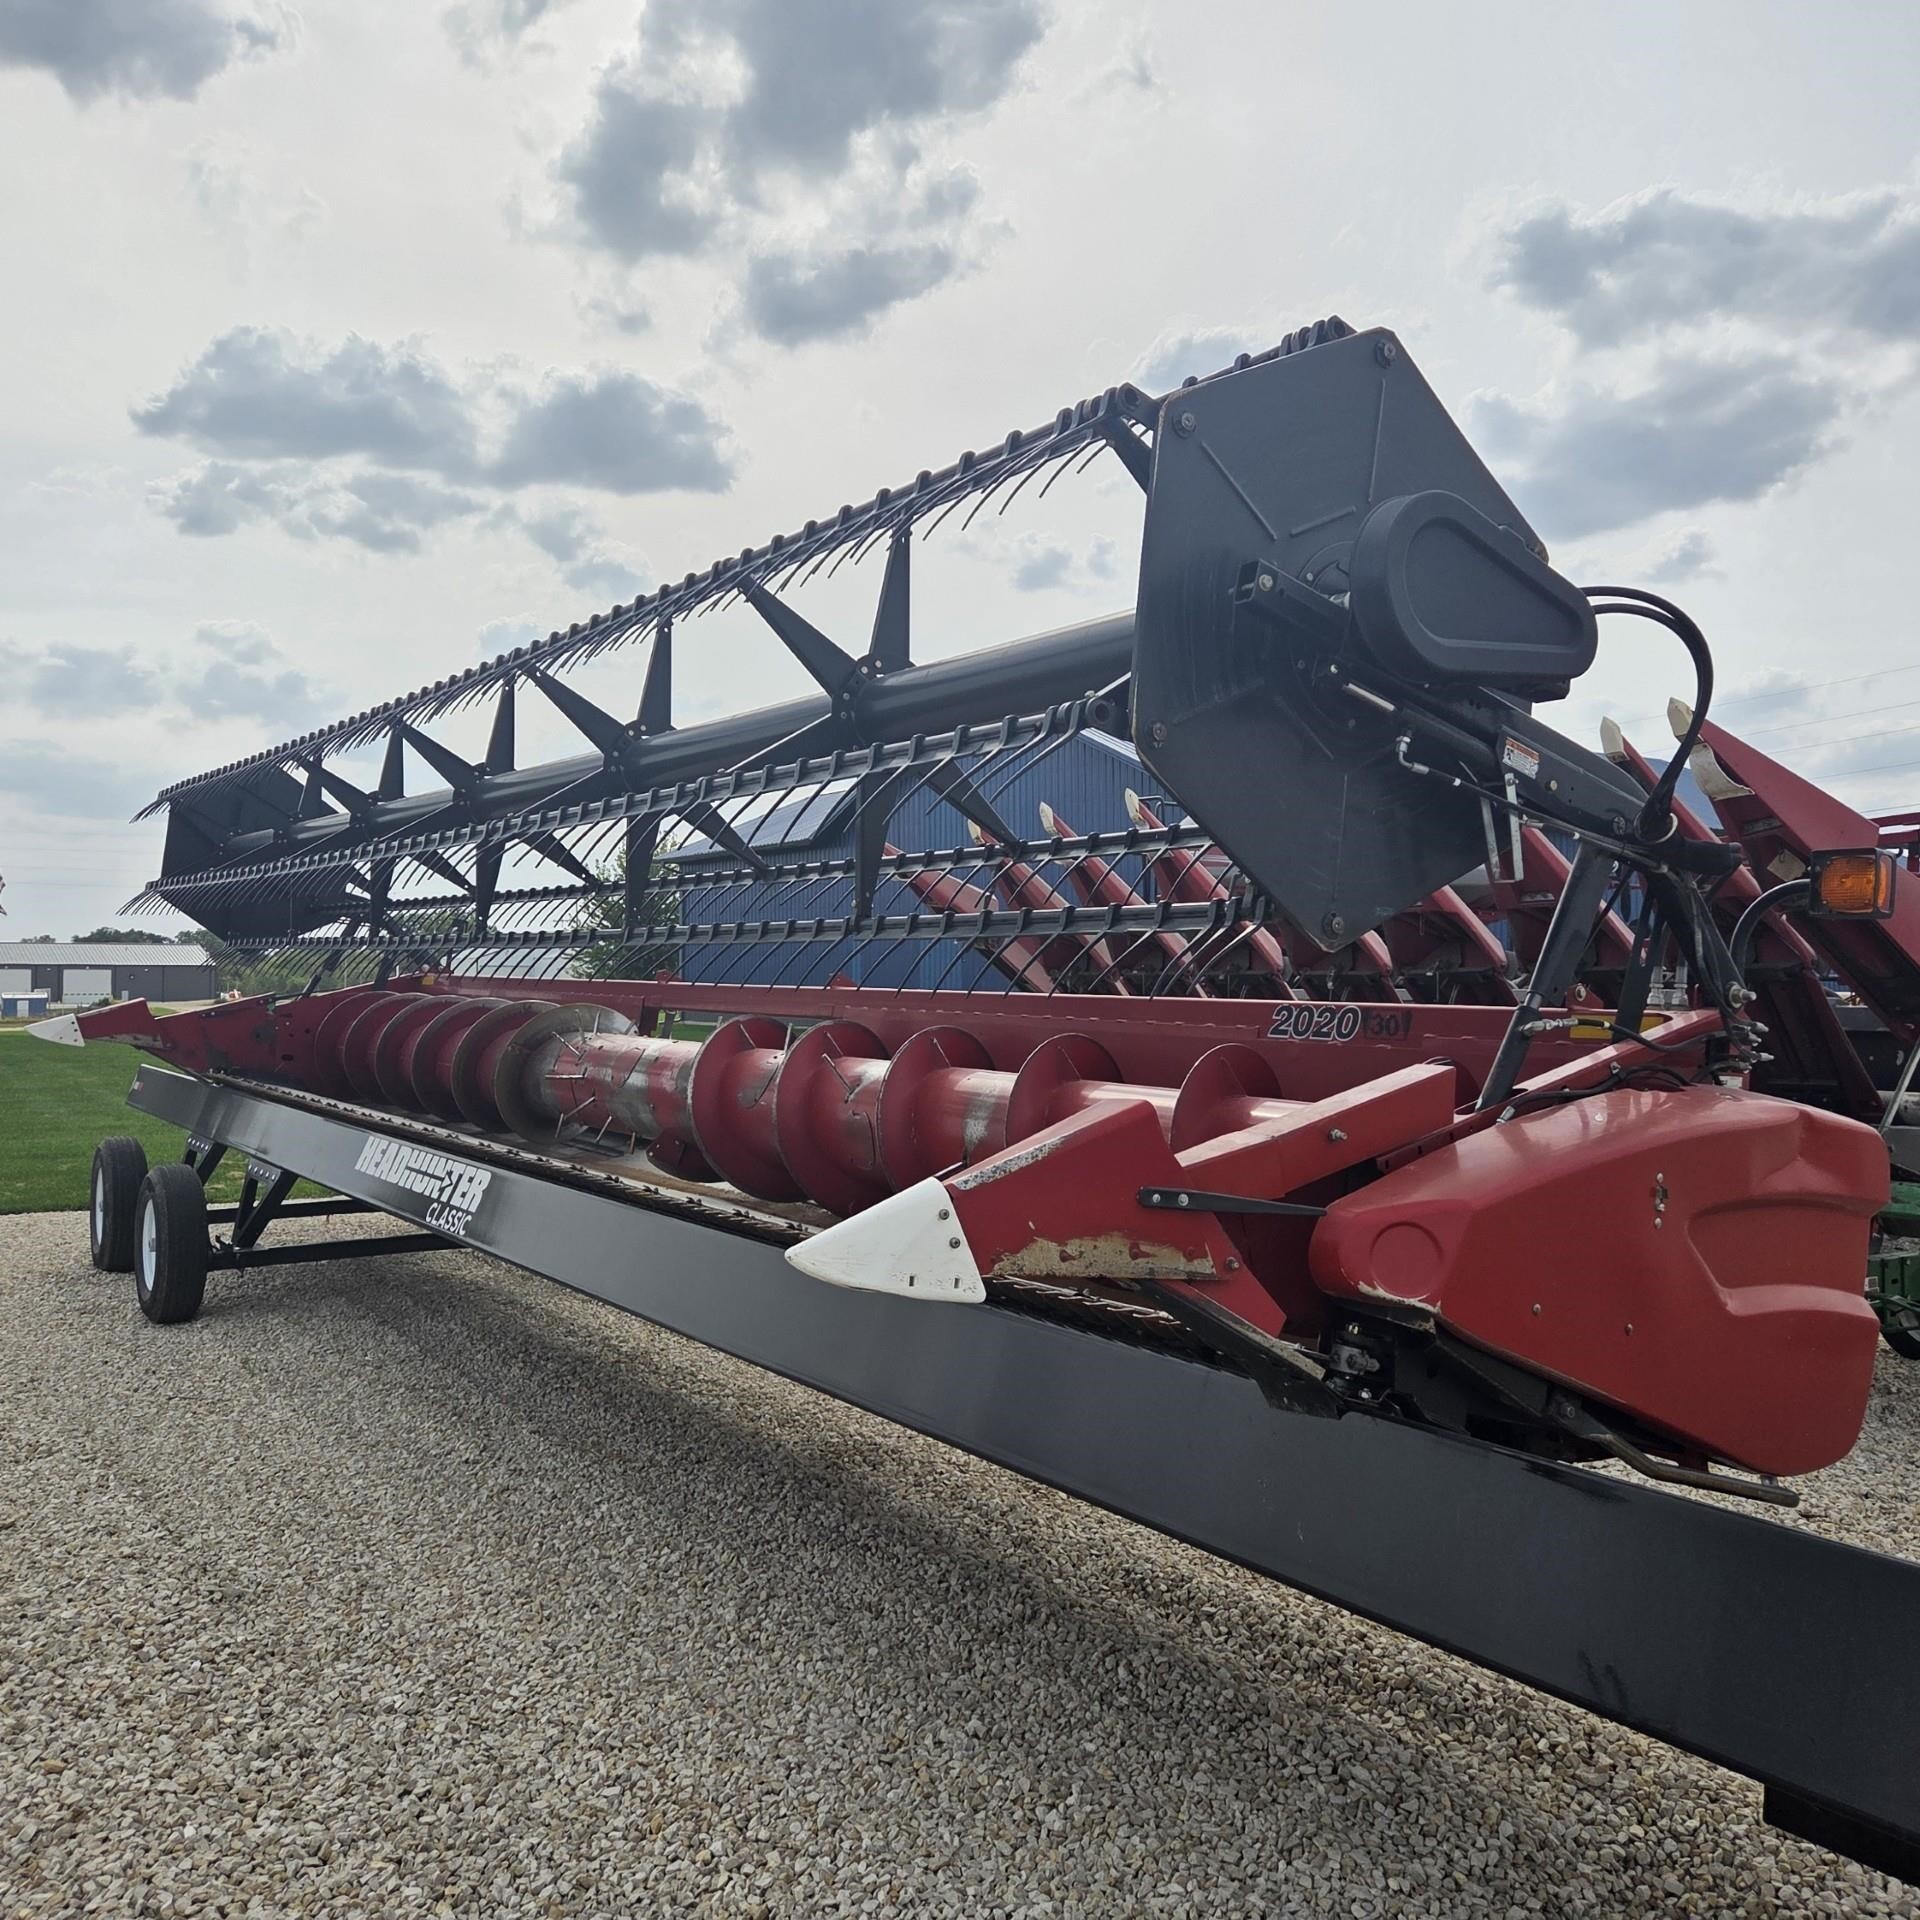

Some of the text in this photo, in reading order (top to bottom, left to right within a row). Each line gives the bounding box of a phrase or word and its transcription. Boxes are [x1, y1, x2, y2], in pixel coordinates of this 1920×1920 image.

[1268, 1004, 1361, 1041] 2020
[355, 1136, 492, 1213] HEADHUNTER
[425, 1202, 472, 1236] CLASSIC
